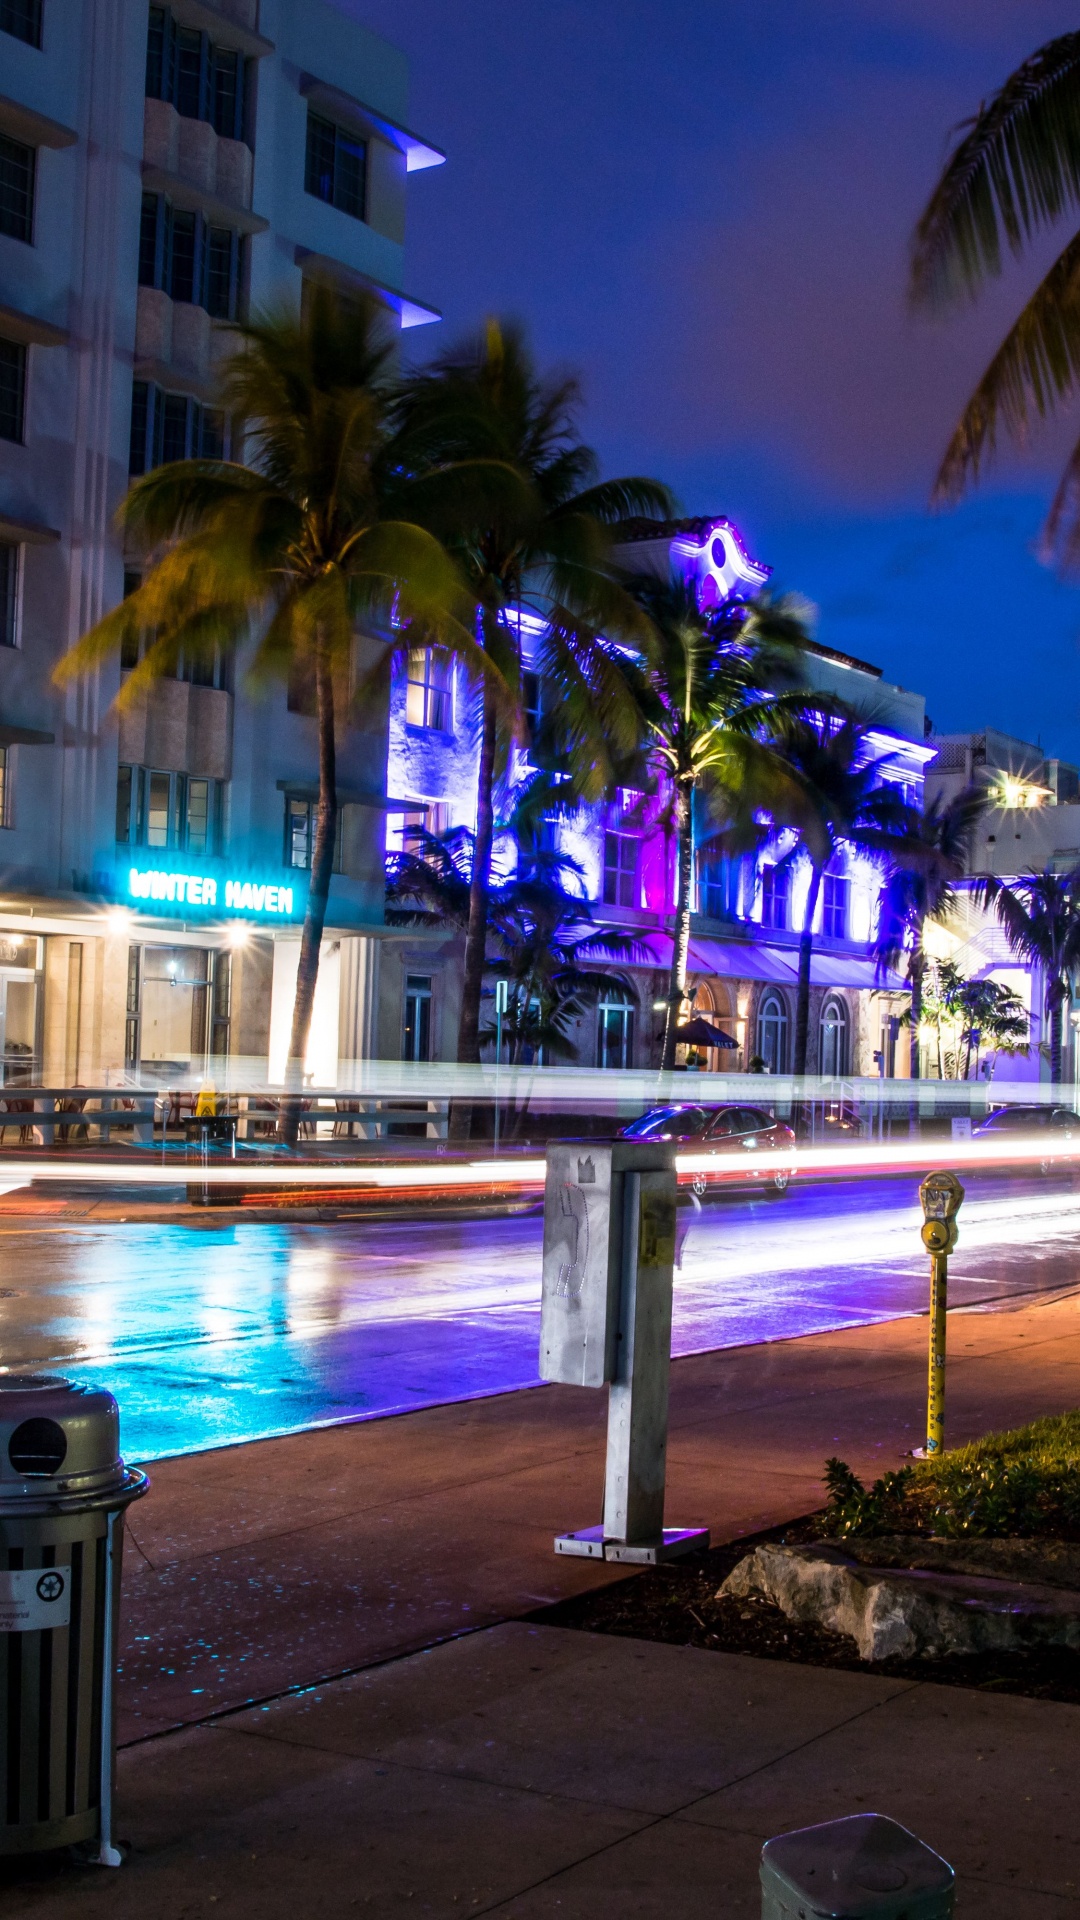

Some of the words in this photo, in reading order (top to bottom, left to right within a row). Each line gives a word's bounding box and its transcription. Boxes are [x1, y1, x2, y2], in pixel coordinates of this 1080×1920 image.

[129, 868, 217, 906] WINTER
[225, 880, 293, 914] HAVEN
[929, 1318, 937, 1430] HOMELESSNESS
